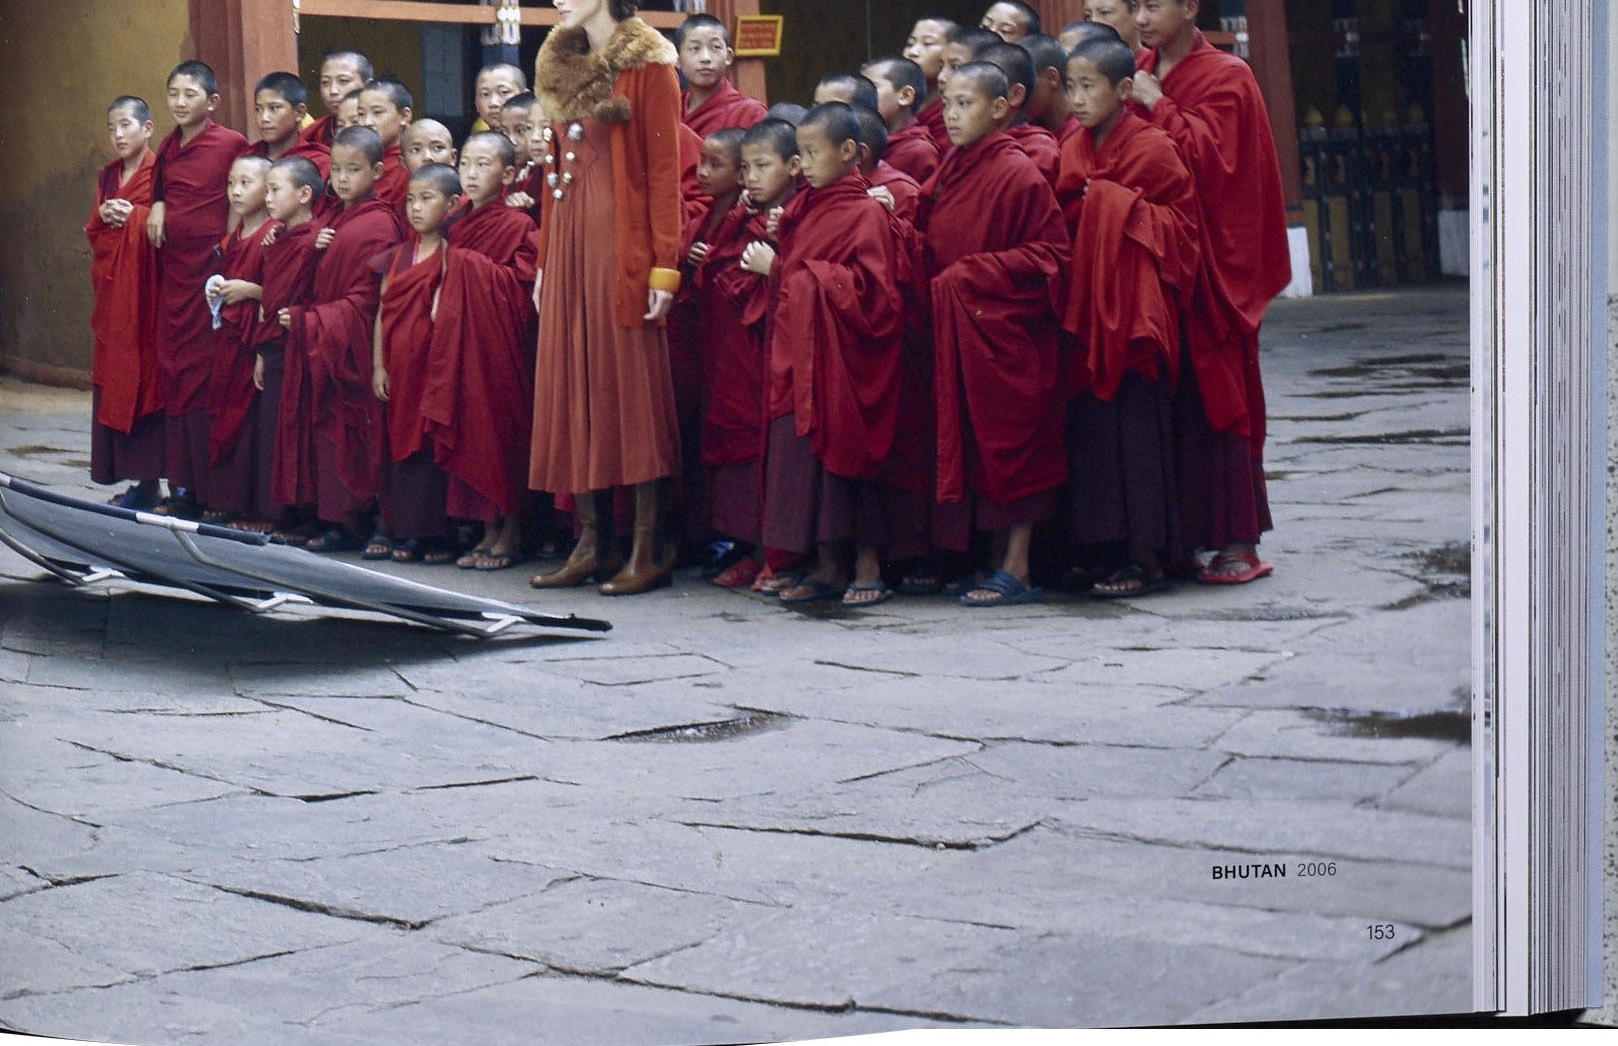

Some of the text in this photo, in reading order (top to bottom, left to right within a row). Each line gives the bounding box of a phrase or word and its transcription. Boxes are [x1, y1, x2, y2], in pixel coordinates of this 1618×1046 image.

[1211, 862, 1337, 879] BHUTAN 2006
[1366, 924, 1395, 940] 153
